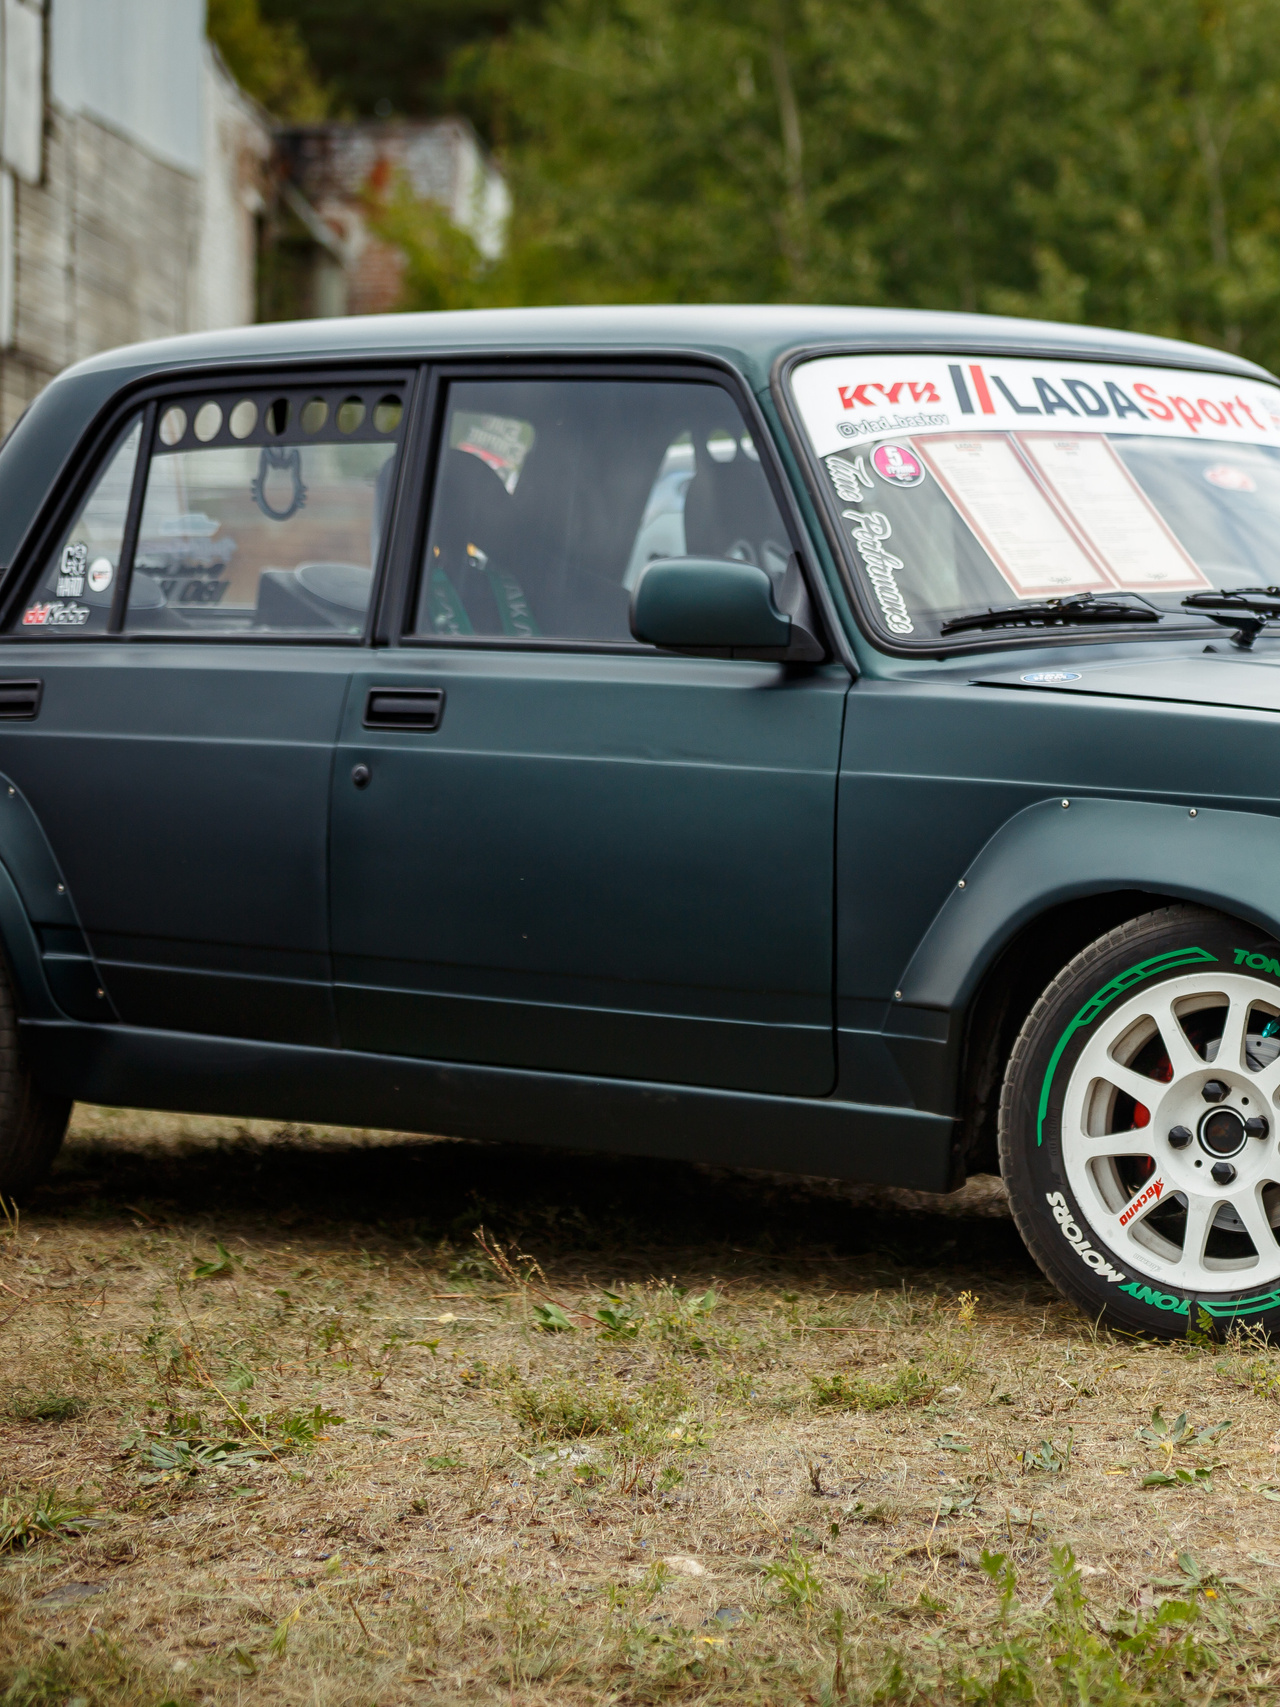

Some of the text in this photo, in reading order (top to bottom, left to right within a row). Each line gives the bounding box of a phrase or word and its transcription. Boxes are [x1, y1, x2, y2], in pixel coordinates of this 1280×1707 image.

[838, 382, 941, 409] KYB
[1046, 1191, 1192, 1316] TONY MOTORS
